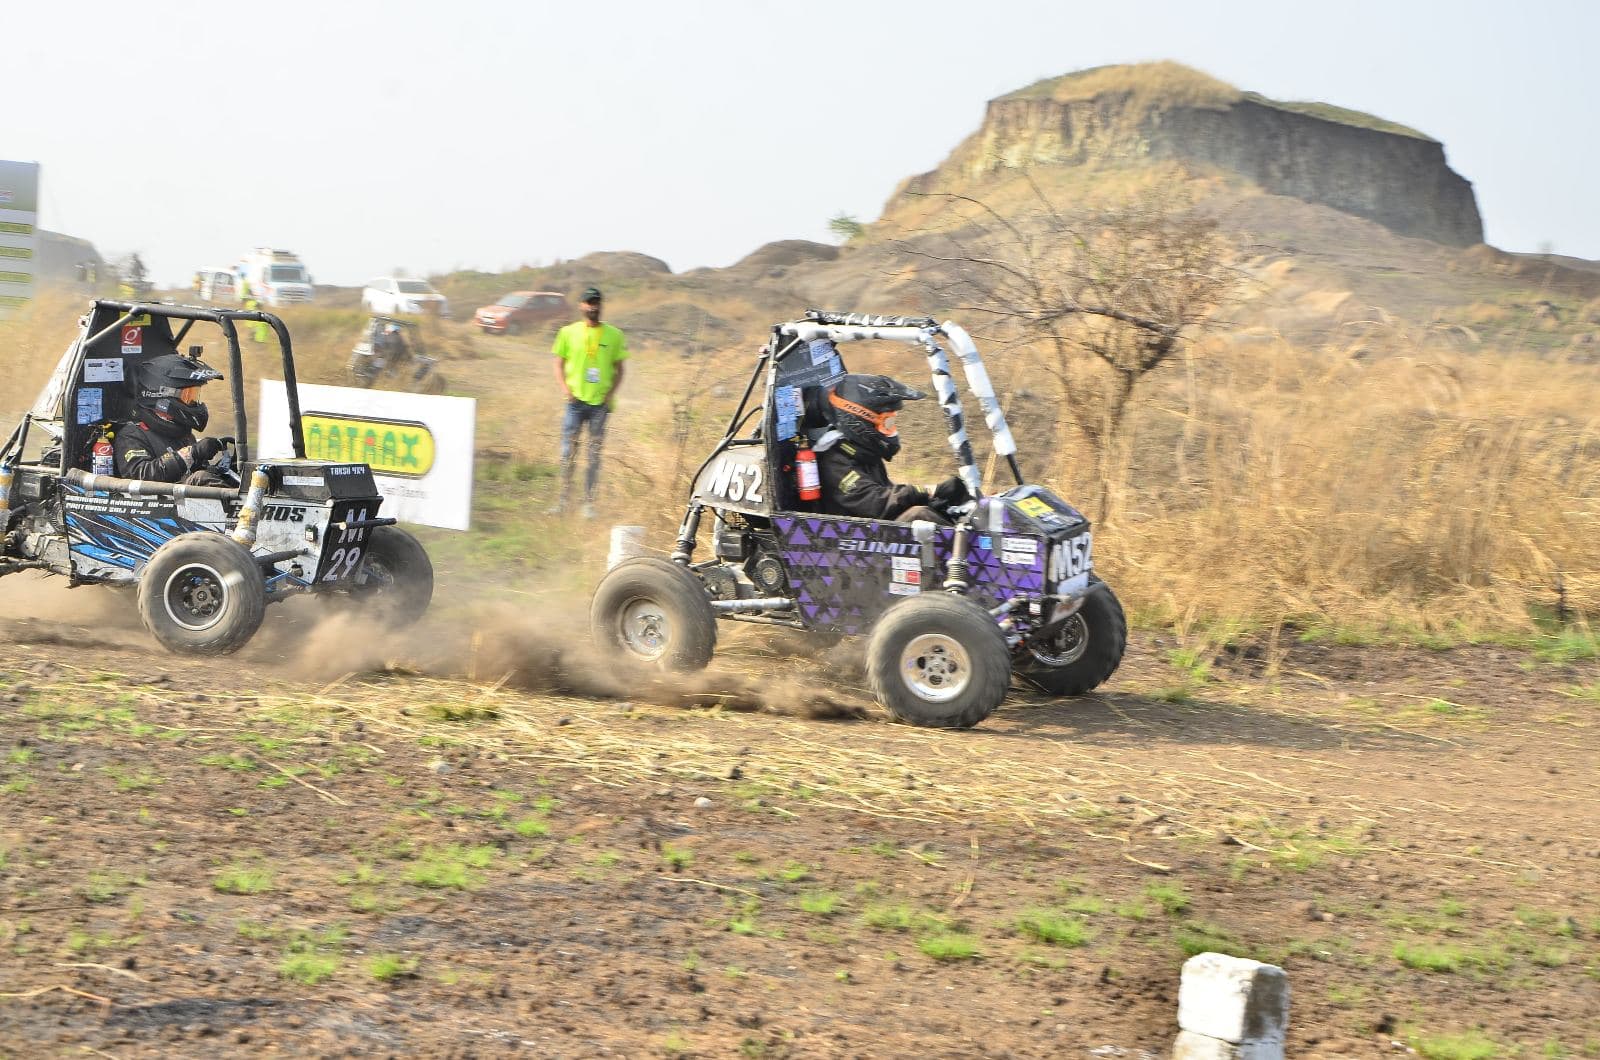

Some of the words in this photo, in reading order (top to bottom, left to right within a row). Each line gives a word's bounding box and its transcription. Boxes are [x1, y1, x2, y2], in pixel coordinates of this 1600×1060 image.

[705, 457, 764, 503] M52
[338, 508, 367, 544] M
[322, 547, 362, 582] 29
[1048, 531, 1094, 583] M52
